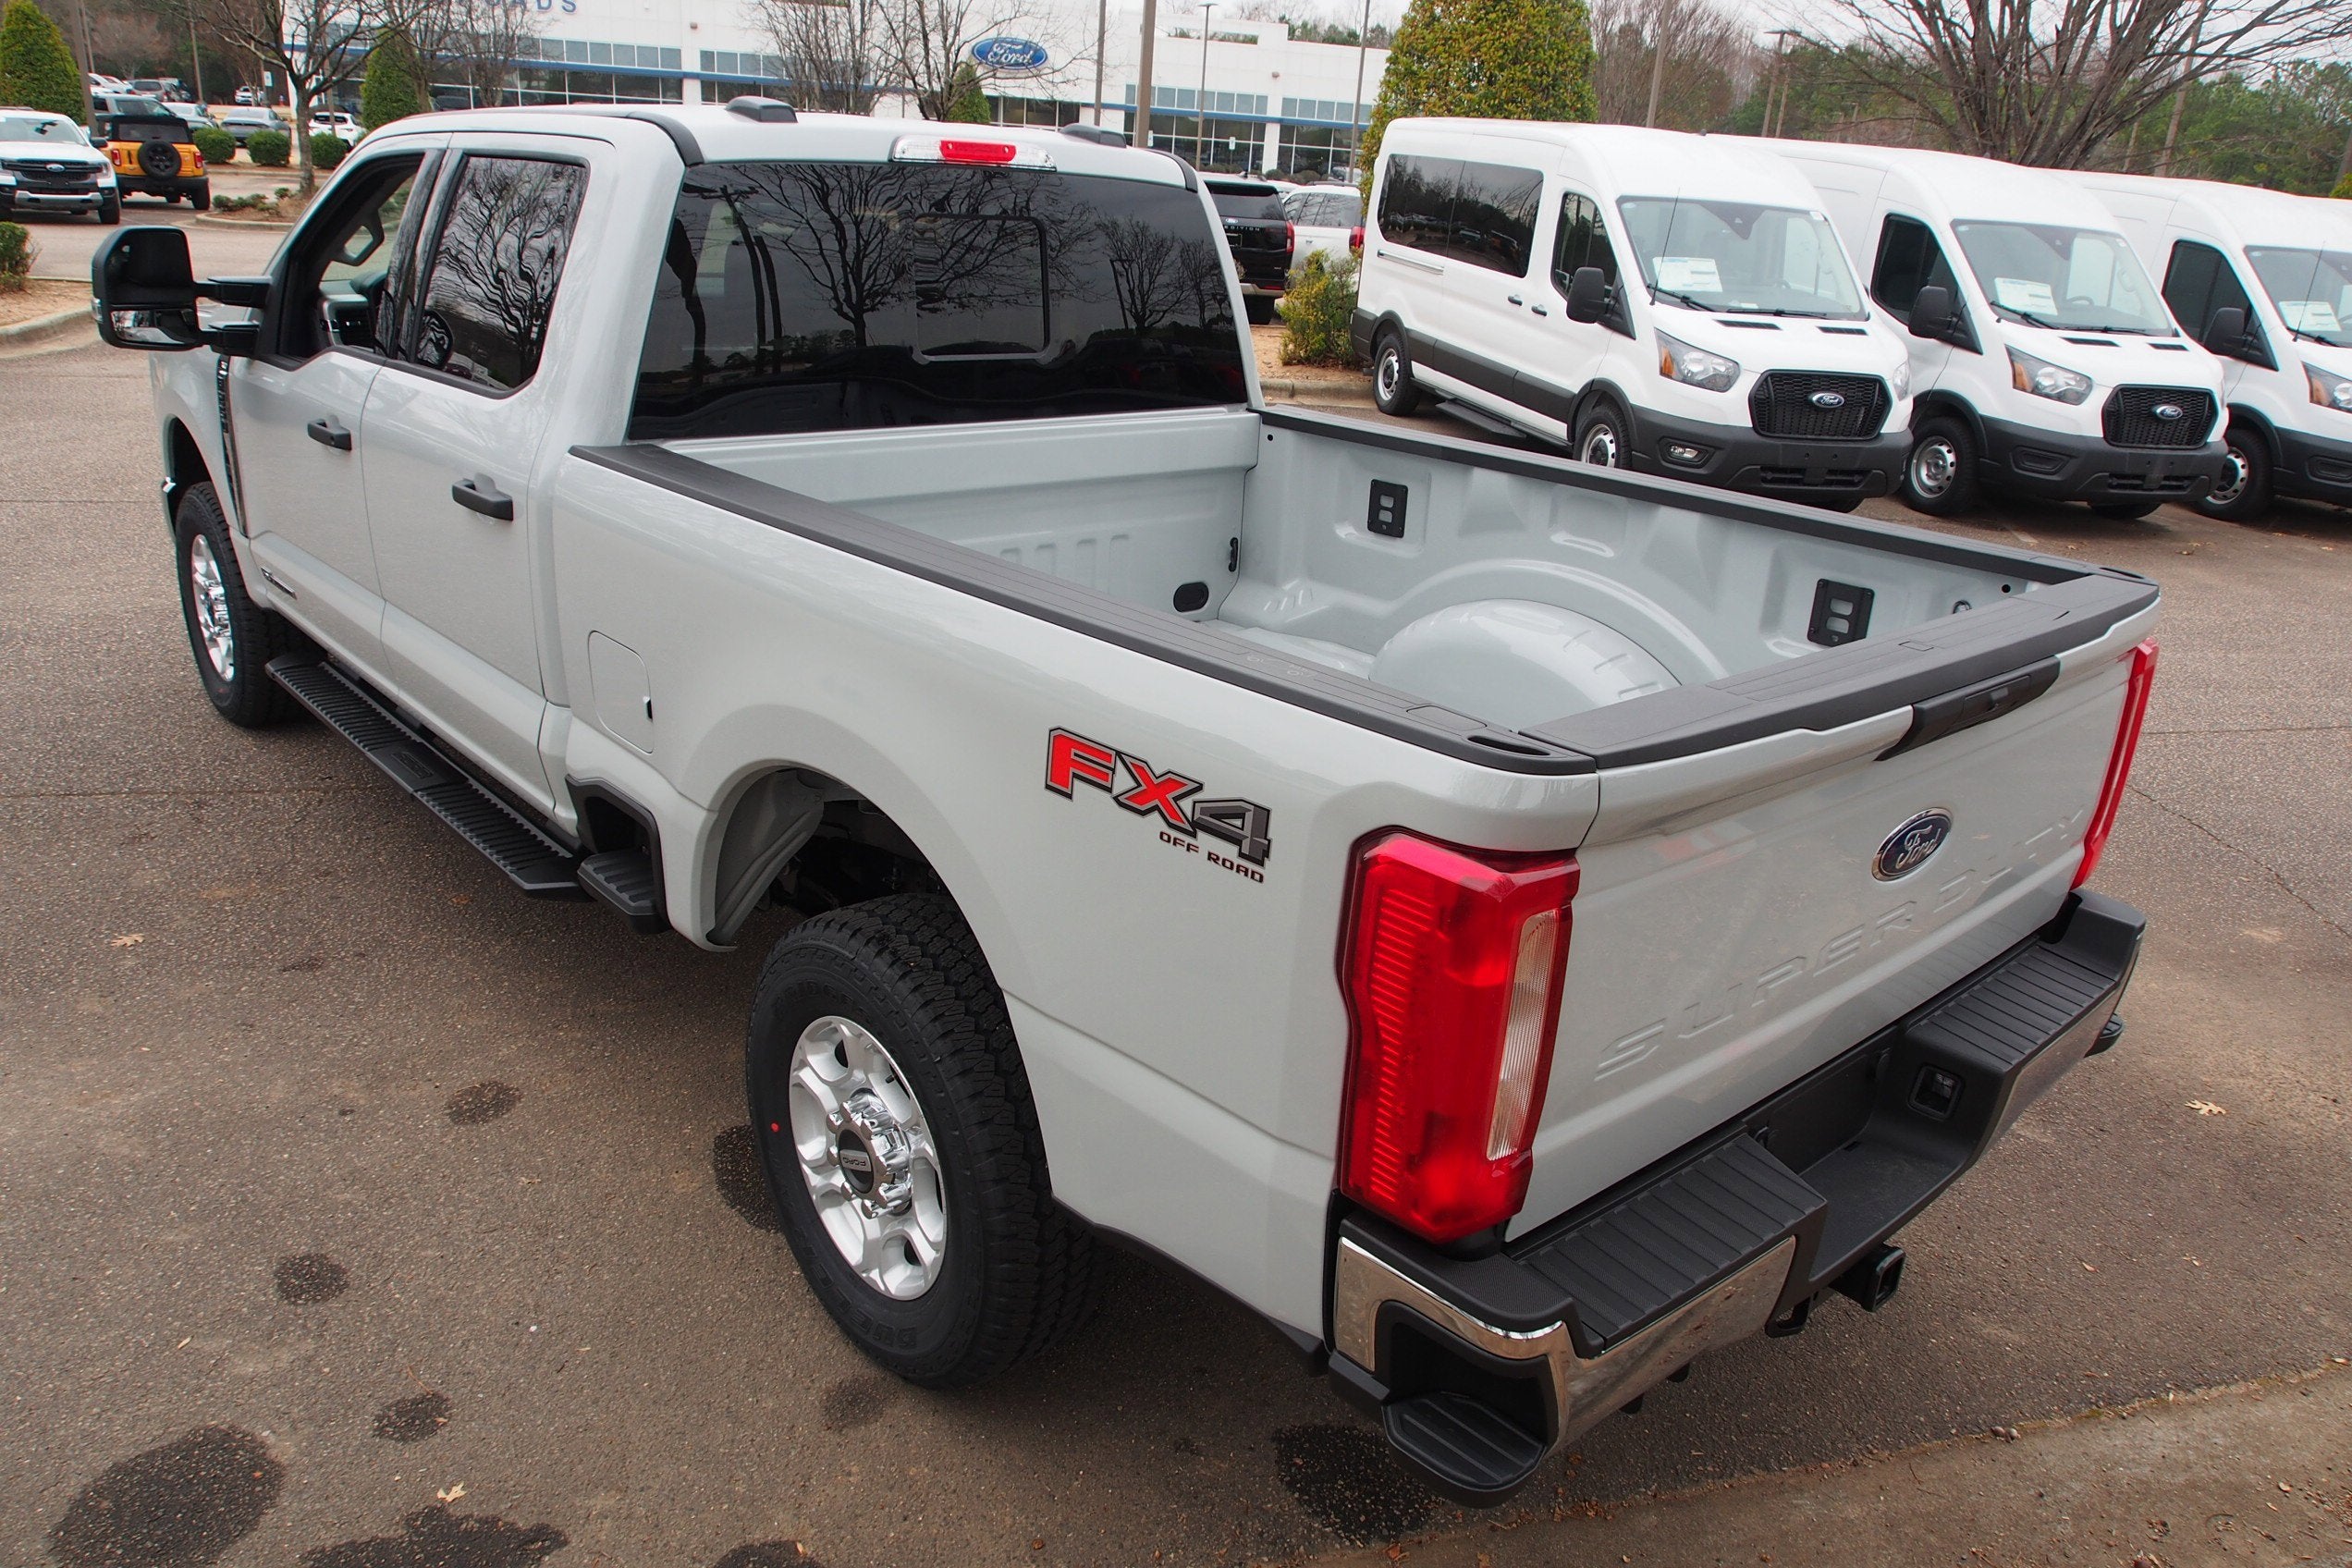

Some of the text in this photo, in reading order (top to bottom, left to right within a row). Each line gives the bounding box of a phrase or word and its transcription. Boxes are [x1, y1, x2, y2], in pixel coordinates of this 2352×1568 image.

[1045, 726, 1272, 868] FX4
[1158, 830, 1265, 884] OFF ROAD
[1594, 900, 1918, 1082] SUPER
[842, 1157, 866, 1167] FORD
